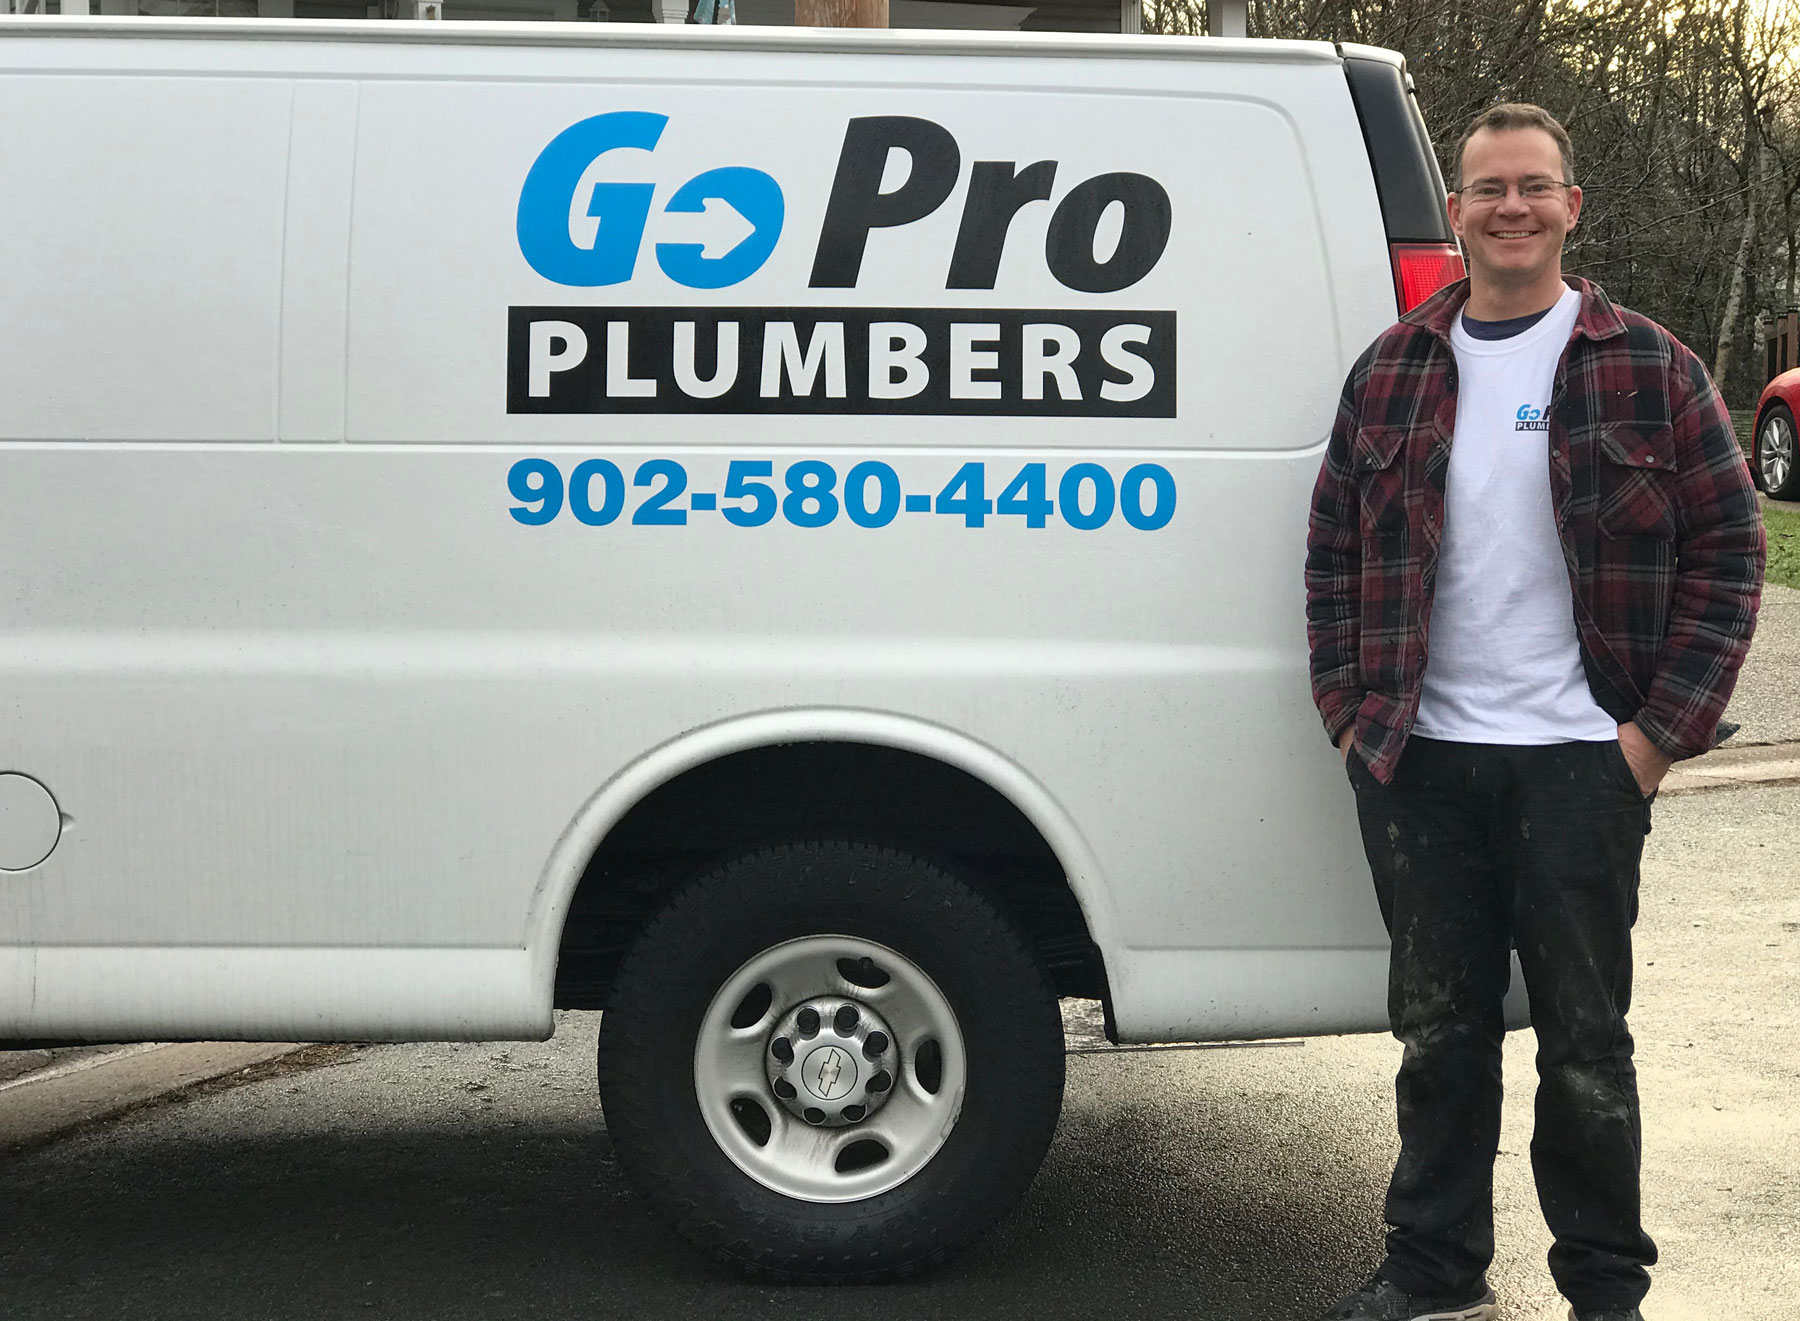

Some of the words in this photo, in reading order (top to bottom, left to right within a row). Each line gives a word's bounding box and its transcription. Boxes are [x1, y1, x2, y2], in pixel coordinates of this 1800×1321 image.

[516, 111, 785, 289] Go
[808, 115, 1172, 293] Pro
[528, 320, 1155, 401] PLUMBERS
[1516, 403, 1541, 420] Go
[507, 458, 1176, 530] 902-580-4400
